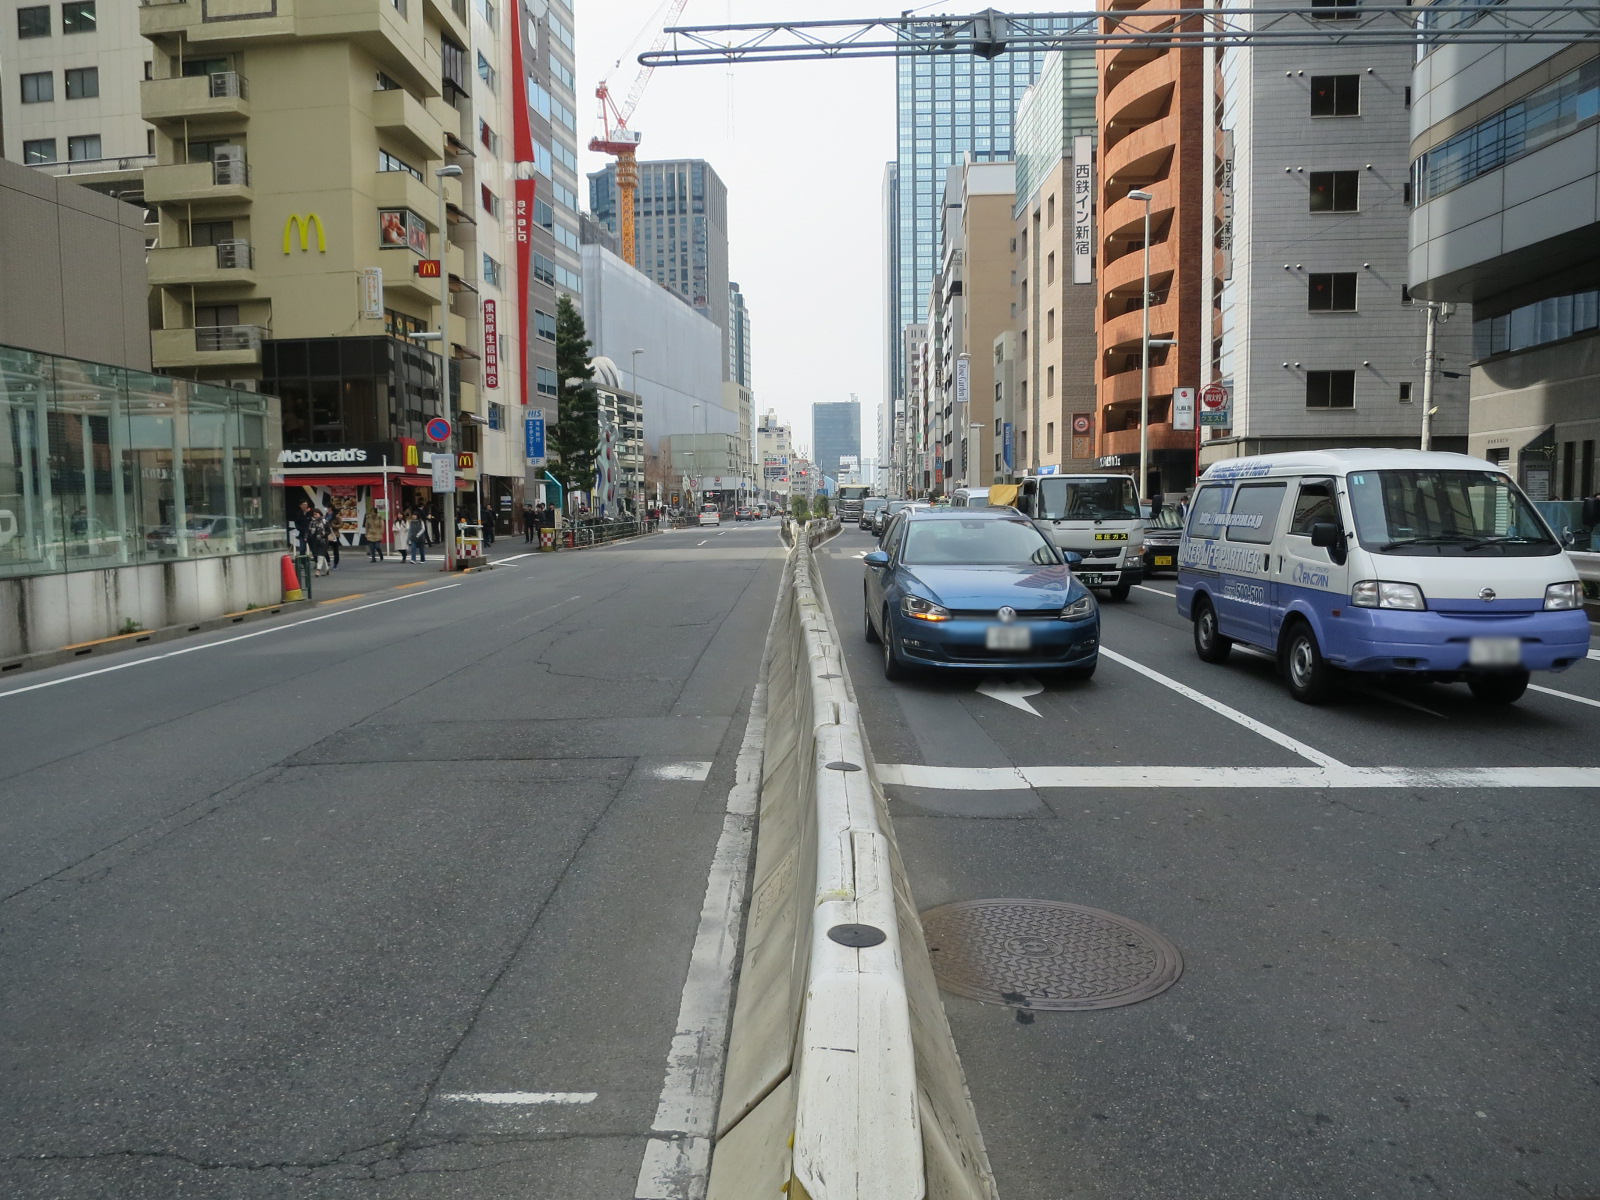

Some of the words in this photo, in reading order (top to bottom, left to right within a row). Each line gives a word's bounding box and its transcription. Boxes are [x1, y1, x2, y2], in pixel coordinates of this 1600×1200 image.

[517, 200, 526, 215] SK
[1075, 164, 1090, 256] 西鉄イン新宿
[517, 218, 527, 244] BLD.
[485, 303, 496, 385] 東京厚生信用組合
[277, 448, 367, 463] McDonald's
[1219, 547, 1260, 575] PARTNER
